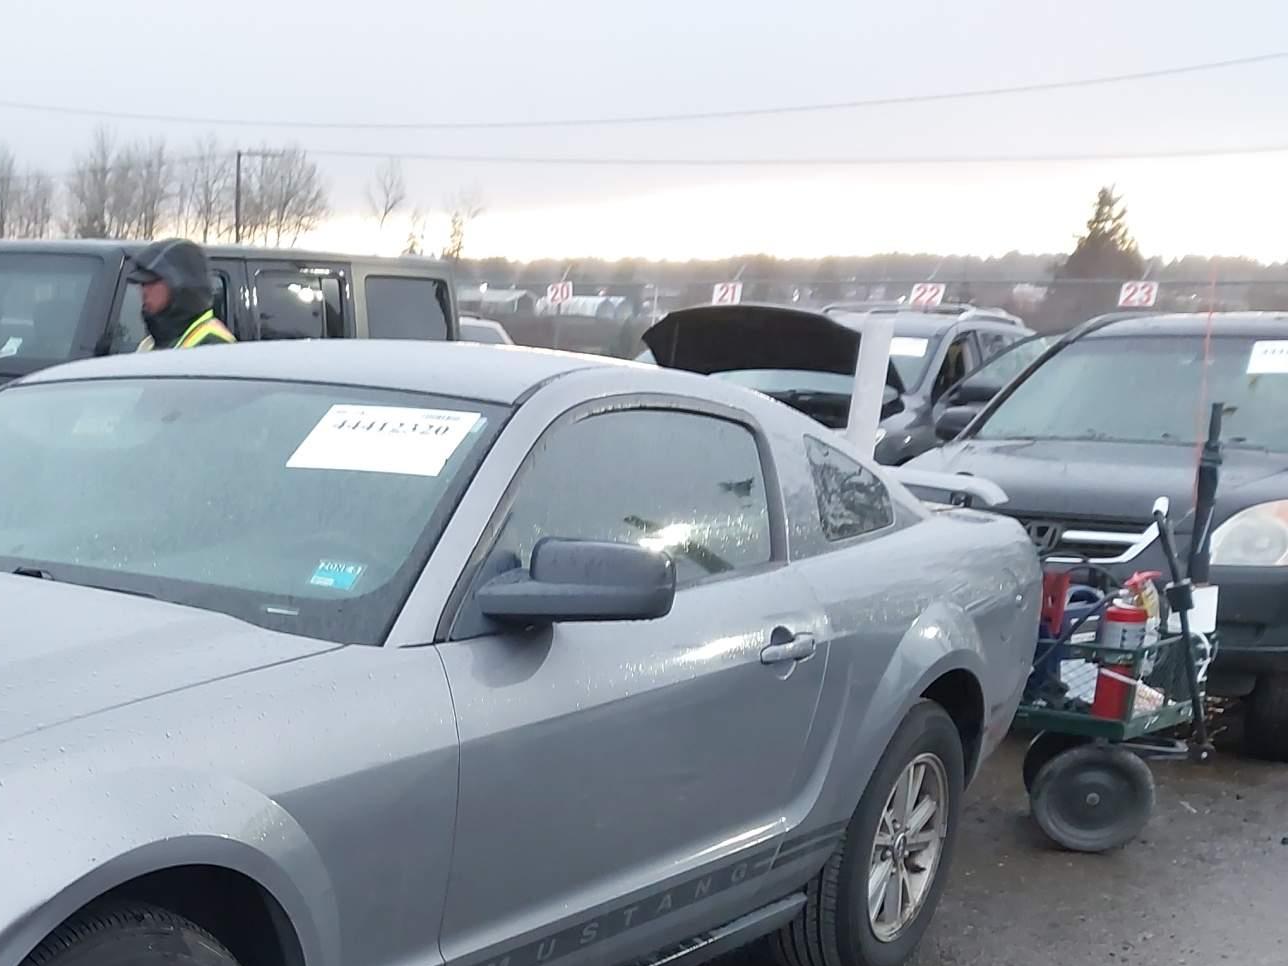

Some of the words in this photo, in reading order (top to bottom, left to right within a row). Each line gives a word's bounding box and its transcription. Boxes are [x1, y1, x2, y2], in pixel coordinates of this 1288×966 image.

[550, 283, 569, 304] 20
[717, 283, 737, 304] 21
[913, 284, 940, 304] 22
[1122, 281, 1154, 305] 23
[332, 419, 450, 436] 44412320
